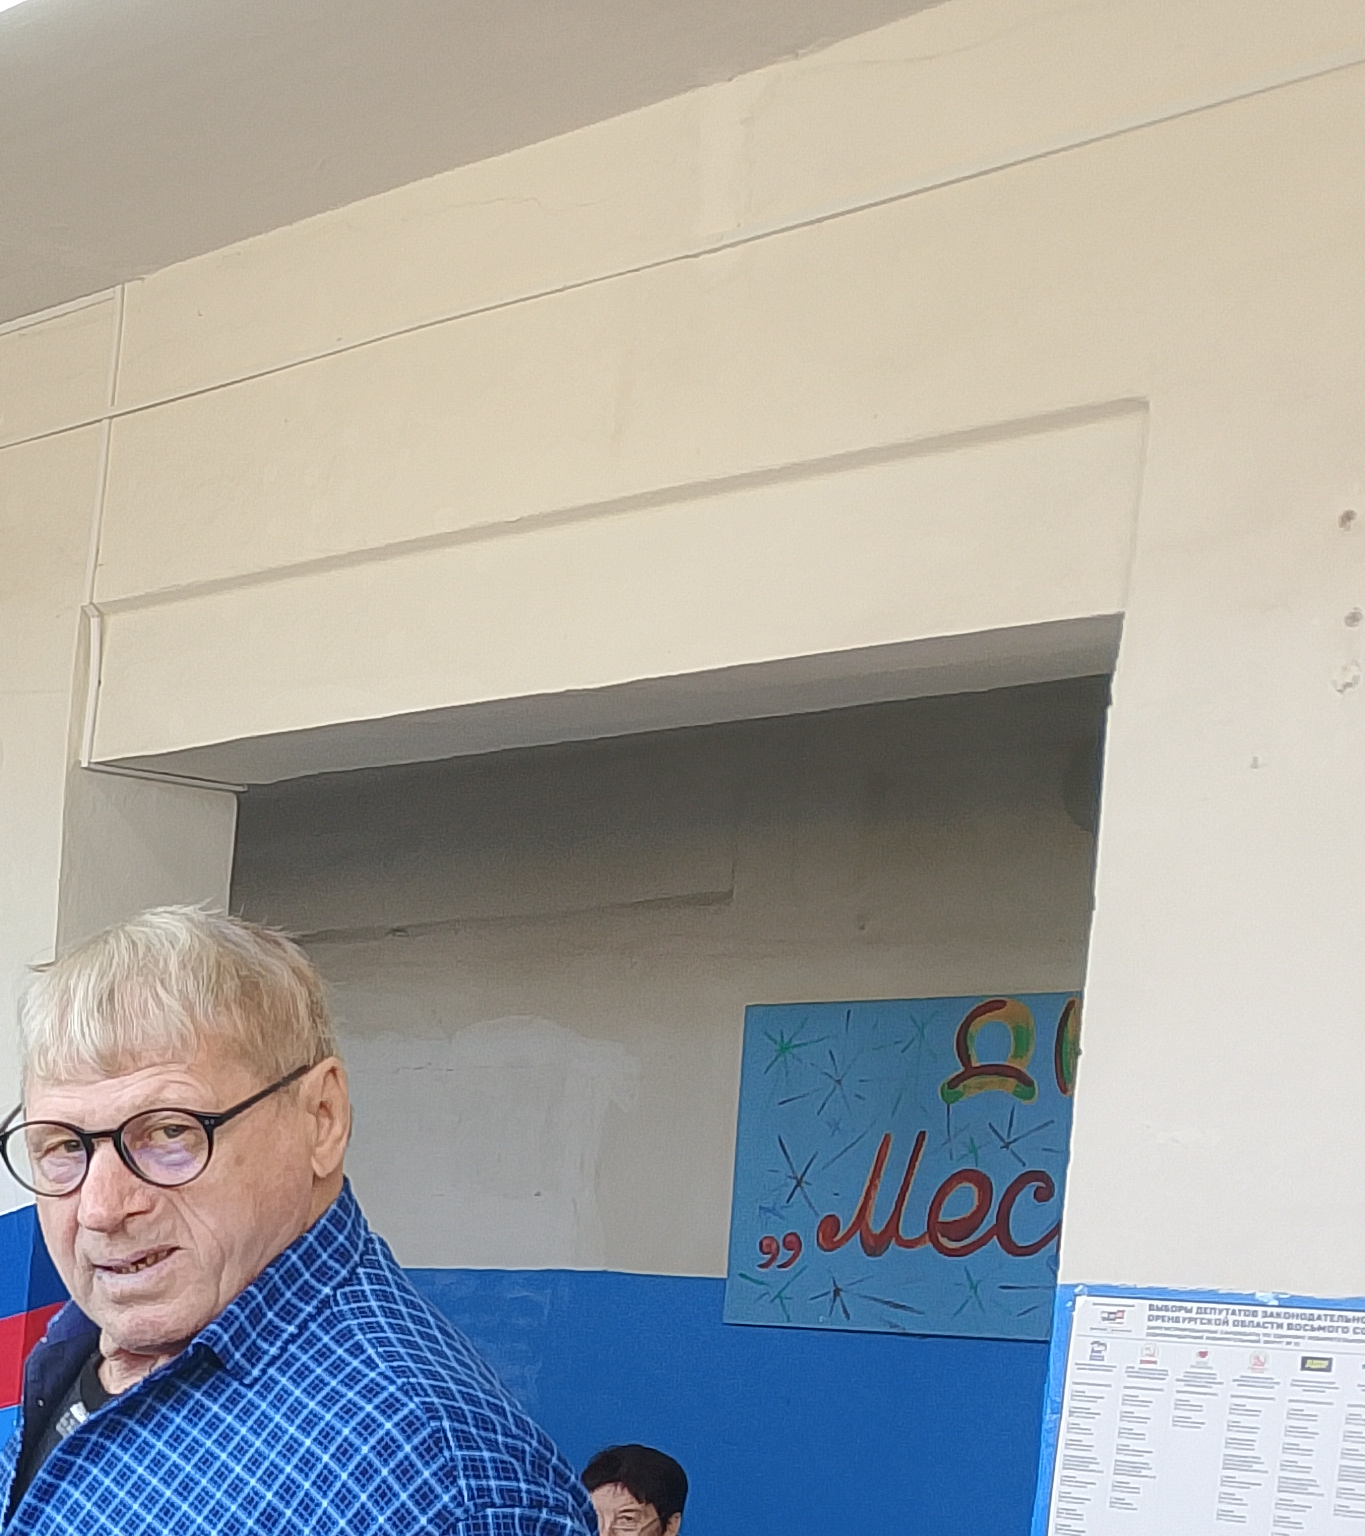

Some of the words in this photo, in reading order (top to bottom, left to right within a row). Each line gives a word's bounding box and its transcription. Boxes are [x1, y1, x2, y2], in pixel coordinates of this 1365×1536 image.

[757, 1130, 1060, 1270] „Мес
[1148, 1303, 1193, 1314] ВЫБОРЫ
[1195, 1306, 1258, 1318] ДЕПУТАТОВ
[1147, 1314, 1230, 1327] ОРЕНБУРГСКОЙ
[1232, 1319, 1284, 1330] ОБЛАСТИ
[1286, 1322, 1350, 1334] ВОСЬМОГО
